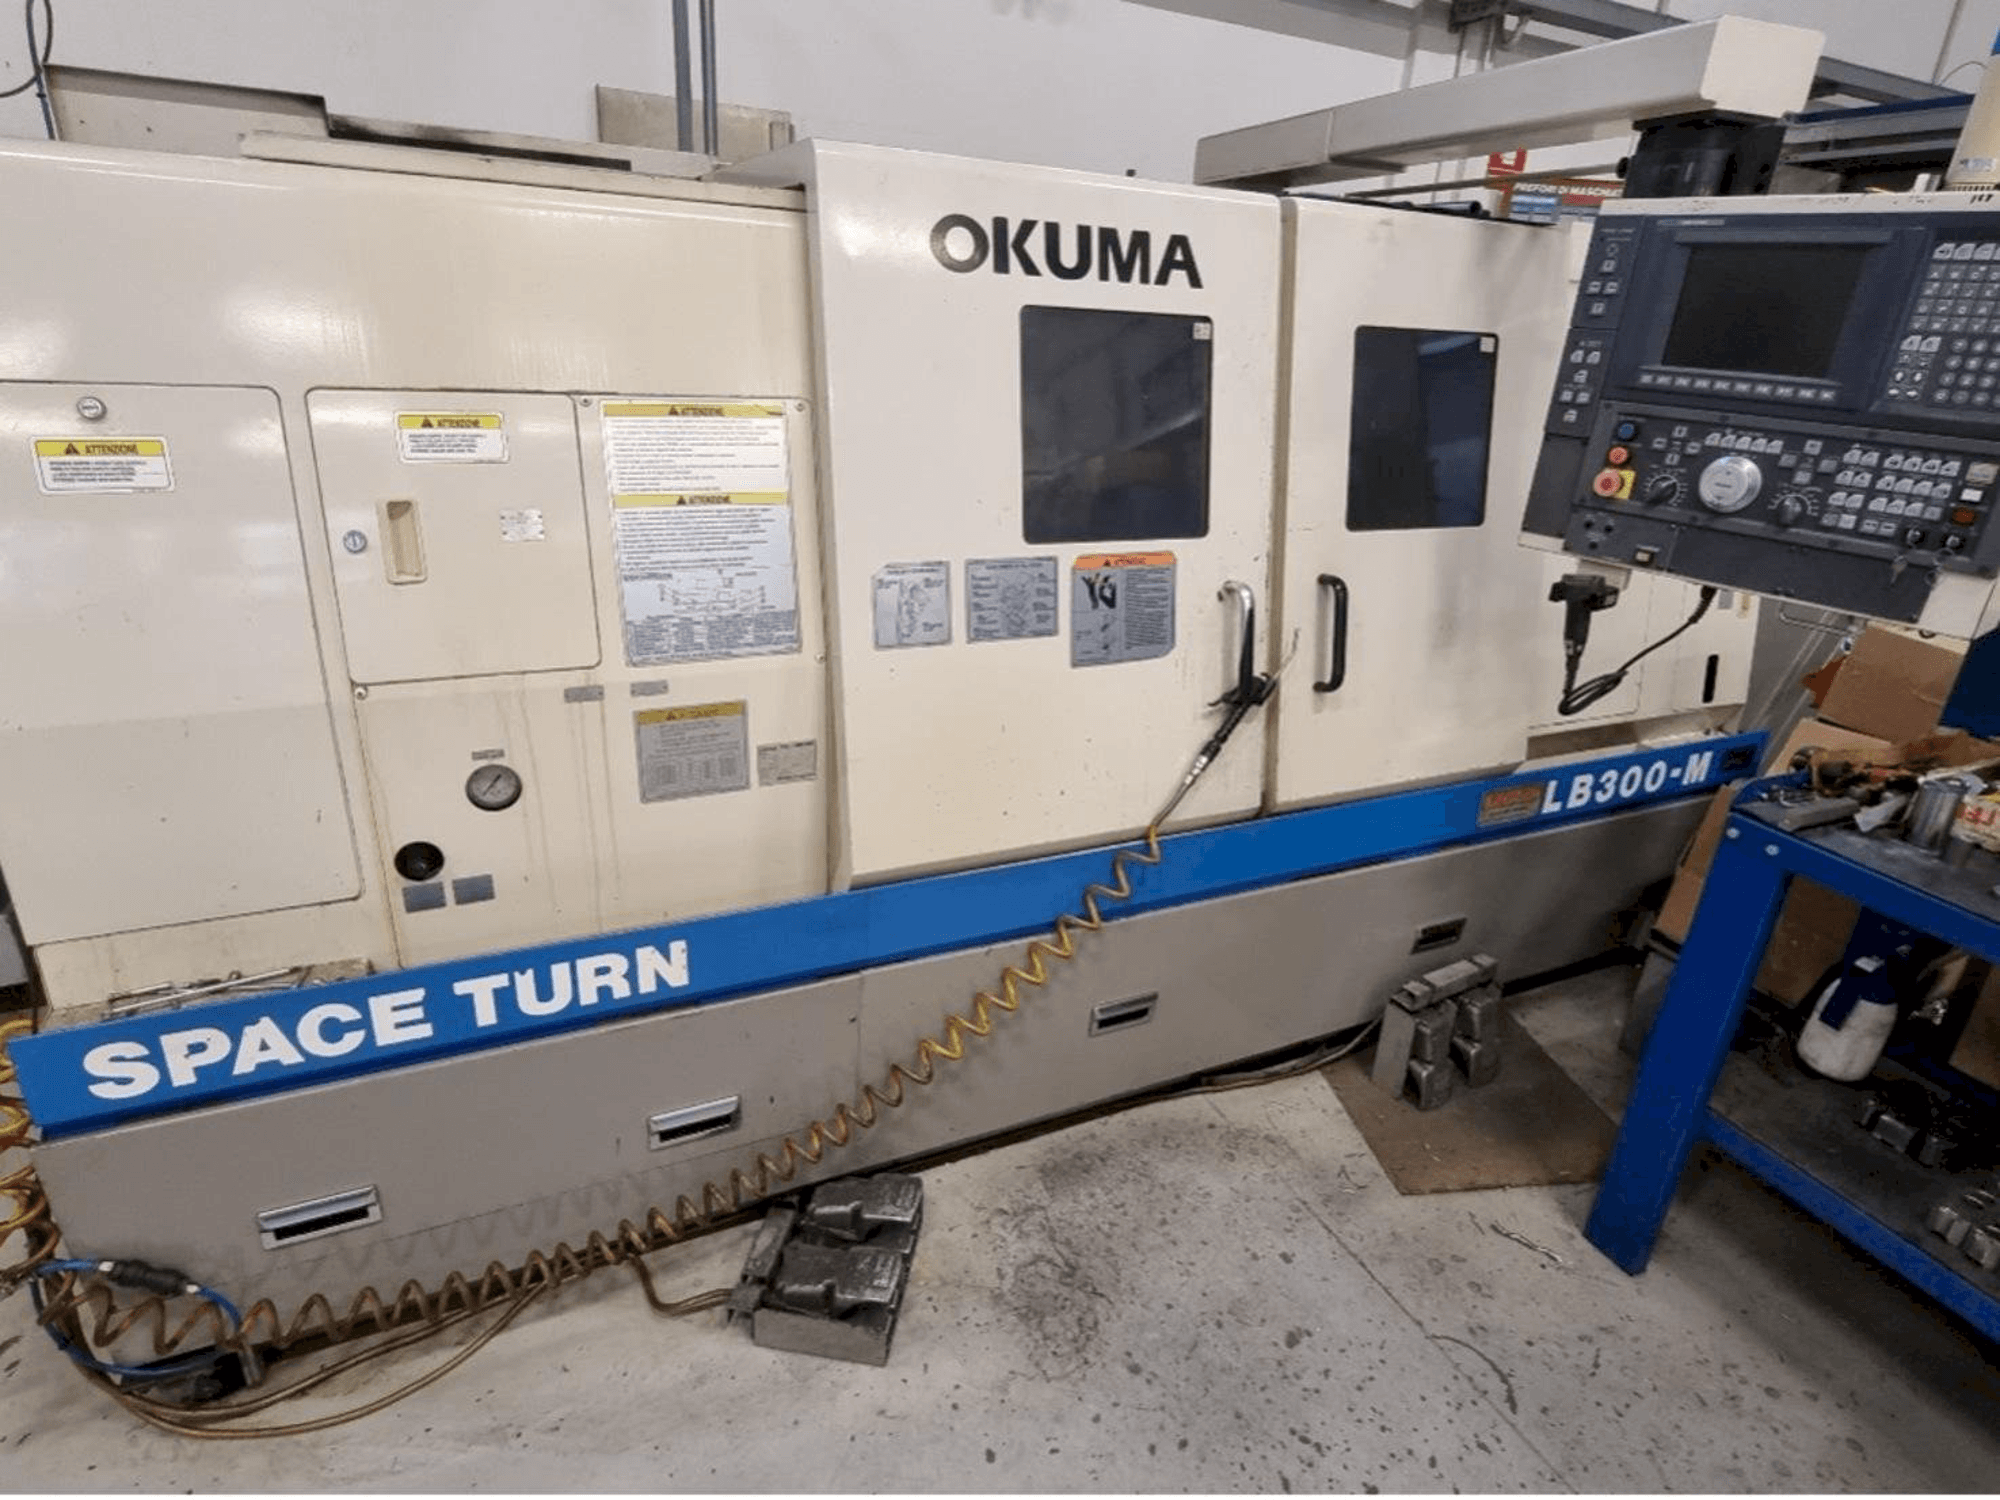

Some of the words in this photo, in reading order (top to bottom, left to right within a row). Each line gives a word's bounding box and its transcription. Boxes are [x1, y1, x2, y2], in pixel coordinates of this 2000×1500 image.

[929, 213, 1204, 290] OKUMA
[1541, 751, 1714, 814] LB300-M
[82, 988, 434, 1100] SPACE
[453, 939, 689, 1028] TURN
